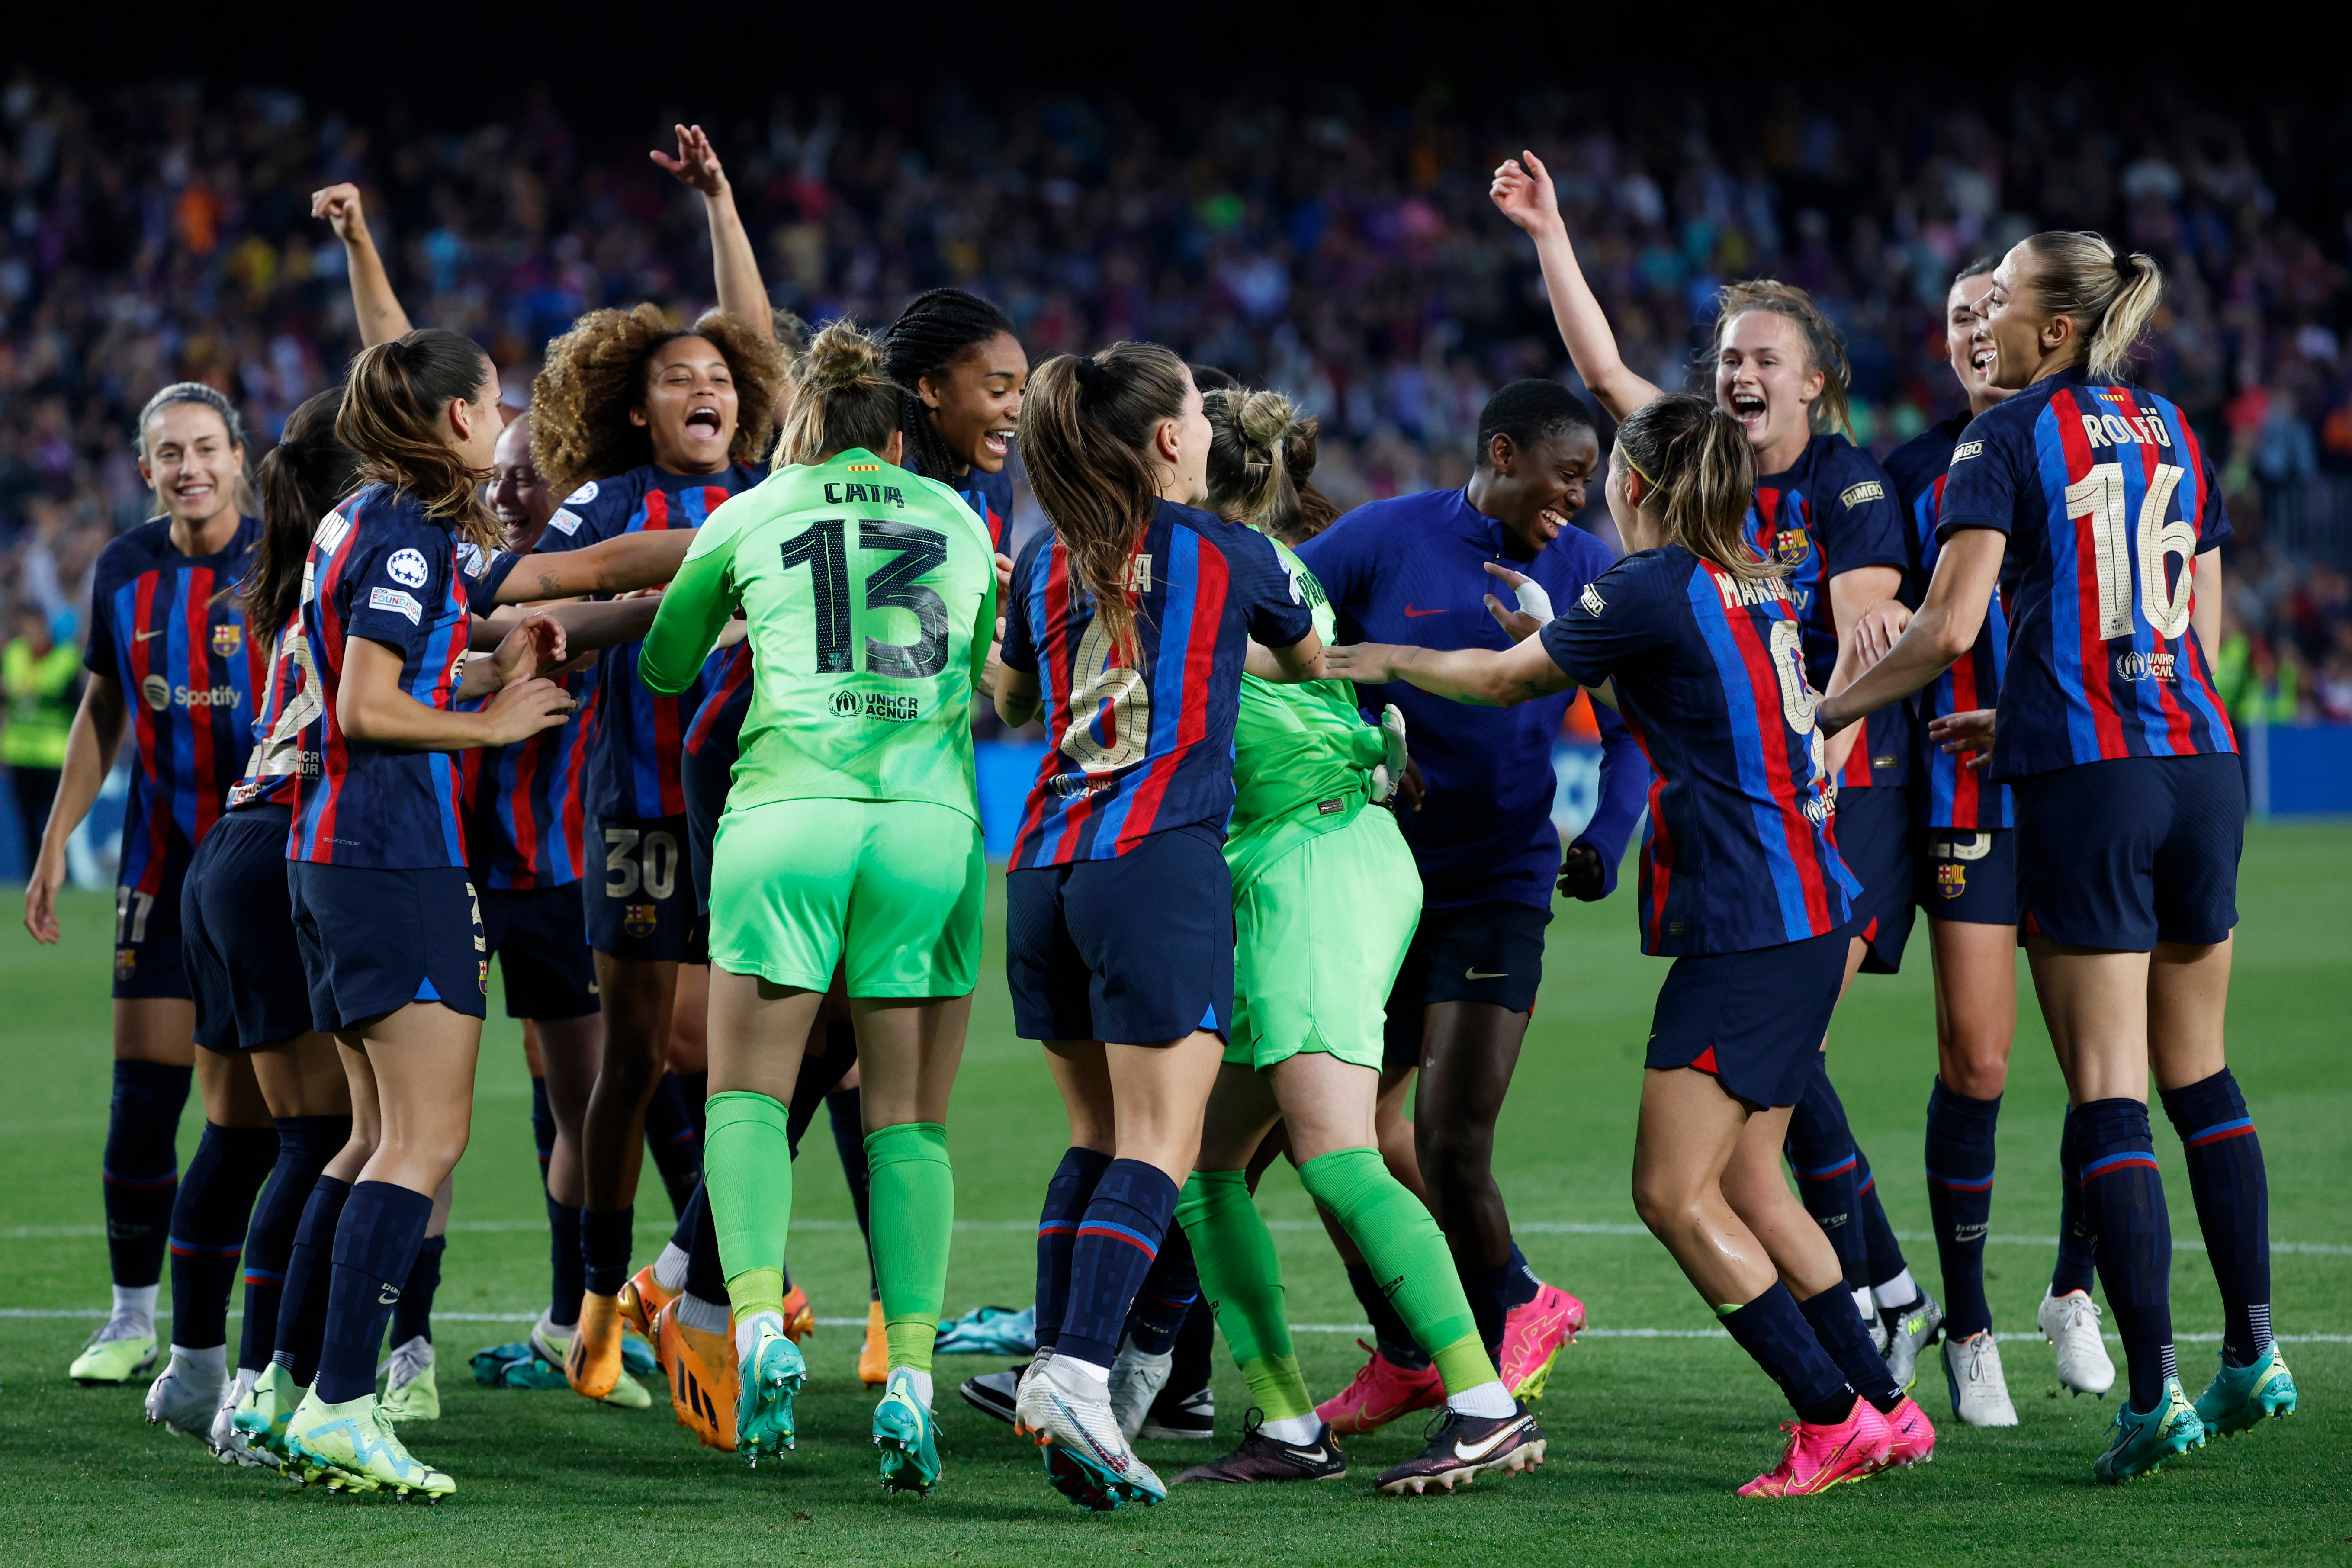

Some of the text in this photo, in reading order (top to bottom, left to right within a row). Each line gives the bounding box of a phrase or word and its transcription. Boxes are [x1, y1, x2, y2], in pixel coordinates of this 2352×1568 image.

[2082, 408, 2172, 449] ROLFÖ
[824, 482, 905, 509] CATA
[1841, 484, 1884, 508] BIMBO
[2065, 462, 2197, 640] 16
[372, 594, 420, 618] FOUNDATION
[779, 519, 949, 679] 13
[174, 685, 242, 710] Spotify
[866, 693, 918, 709] UNHCR
[1060, 606, 1149, 773] 6
[865, 704, 918, 720] ACNUR
[605, 829, 678, 900] 30
[116, 884, 155, 943] 11
